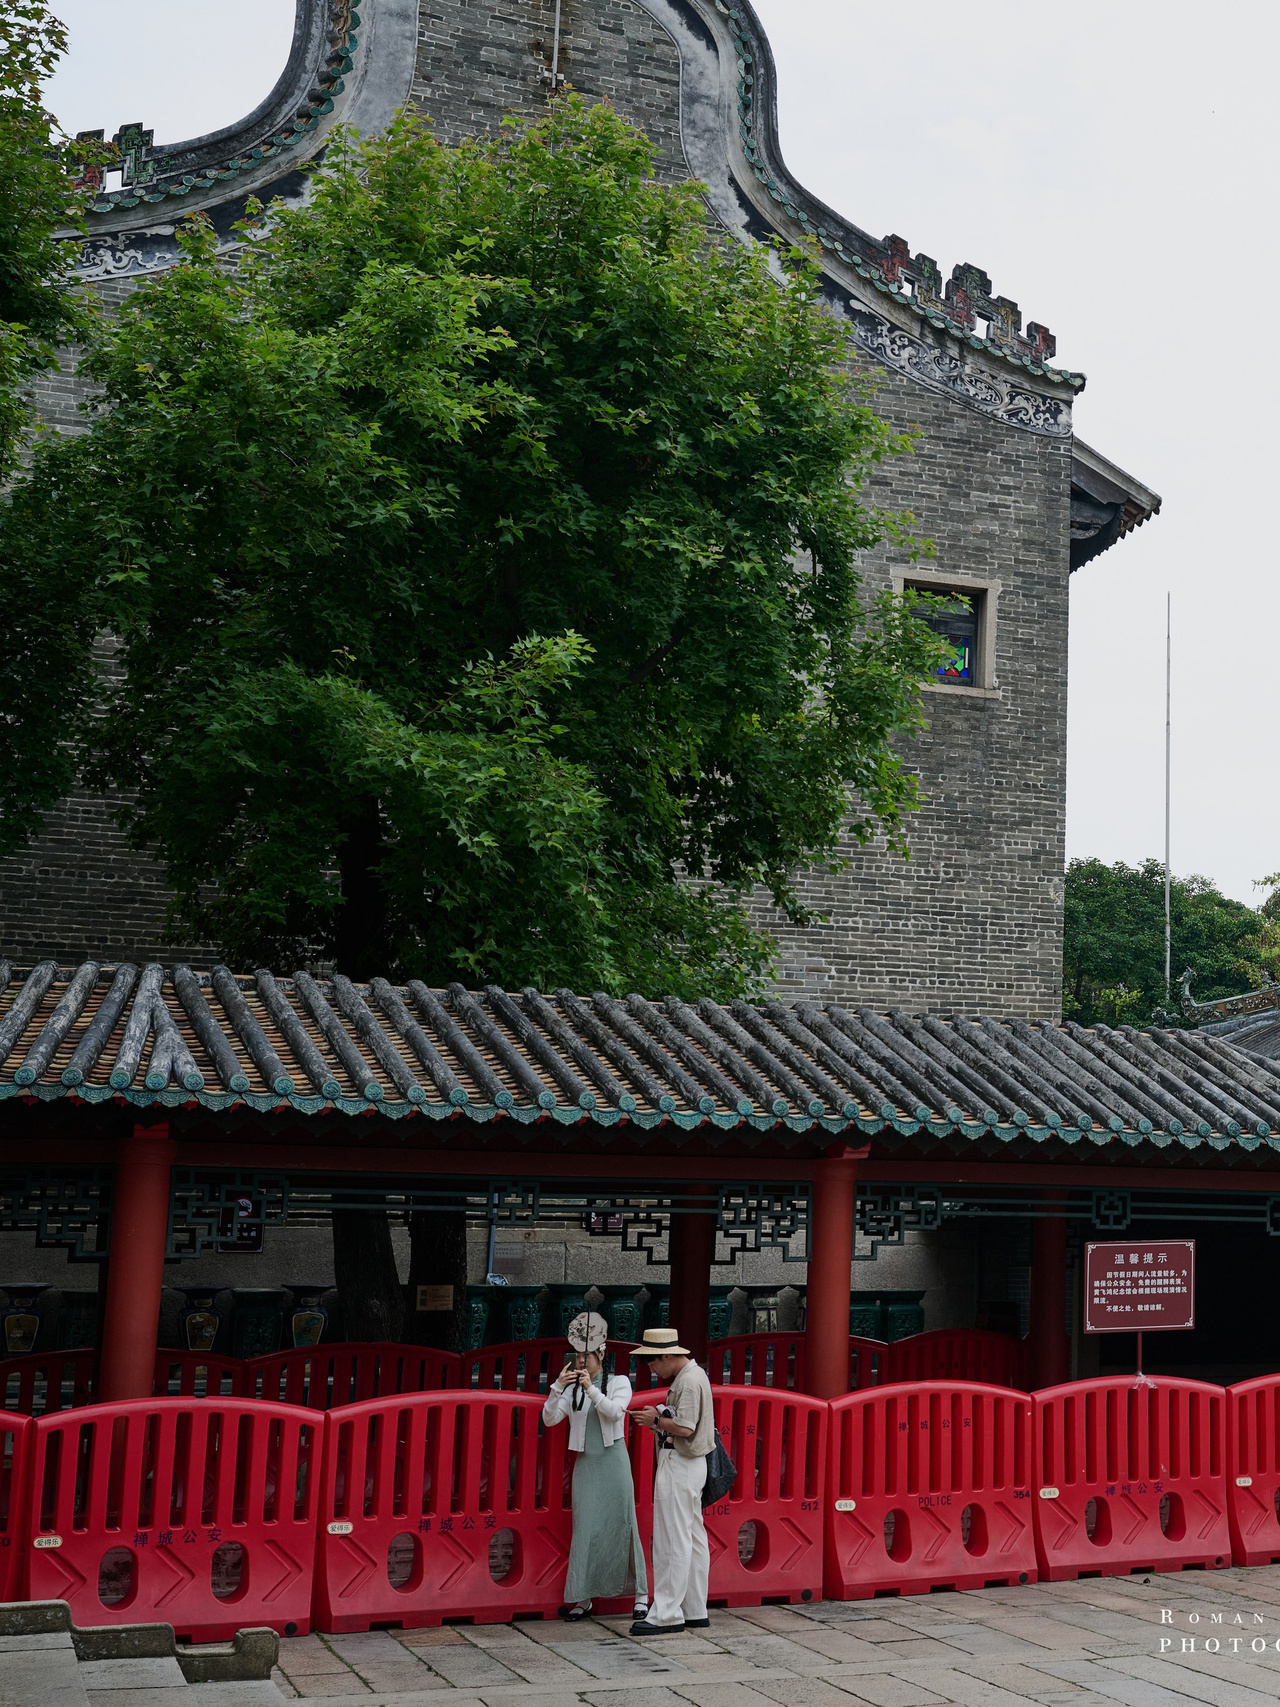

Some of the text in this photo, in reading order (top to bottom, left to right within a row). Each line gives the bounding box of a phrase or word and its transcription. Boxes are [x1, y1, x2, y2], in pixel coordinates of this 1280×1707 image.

[1114, 1252, 1168, 1265] 温馨提示
[721, 1425, 755, 1435] 公安
[898, 1417, 971, 1432] 禅城公安
[1013, 1490, 1031, 1499] 354
[801, 1501, 819, 1511] 512
[918, 1495, 952, 1507] POLICE
[702, 1504, 731, 1516] LICE
[329, 1524, 351, 1532] 爱得乐
[417, 1515, 497, 1533] 禅城公安
[36, 1537, 60, 1547] 爱得乐
[133, 1528, 223, 1547] 禅城公安
